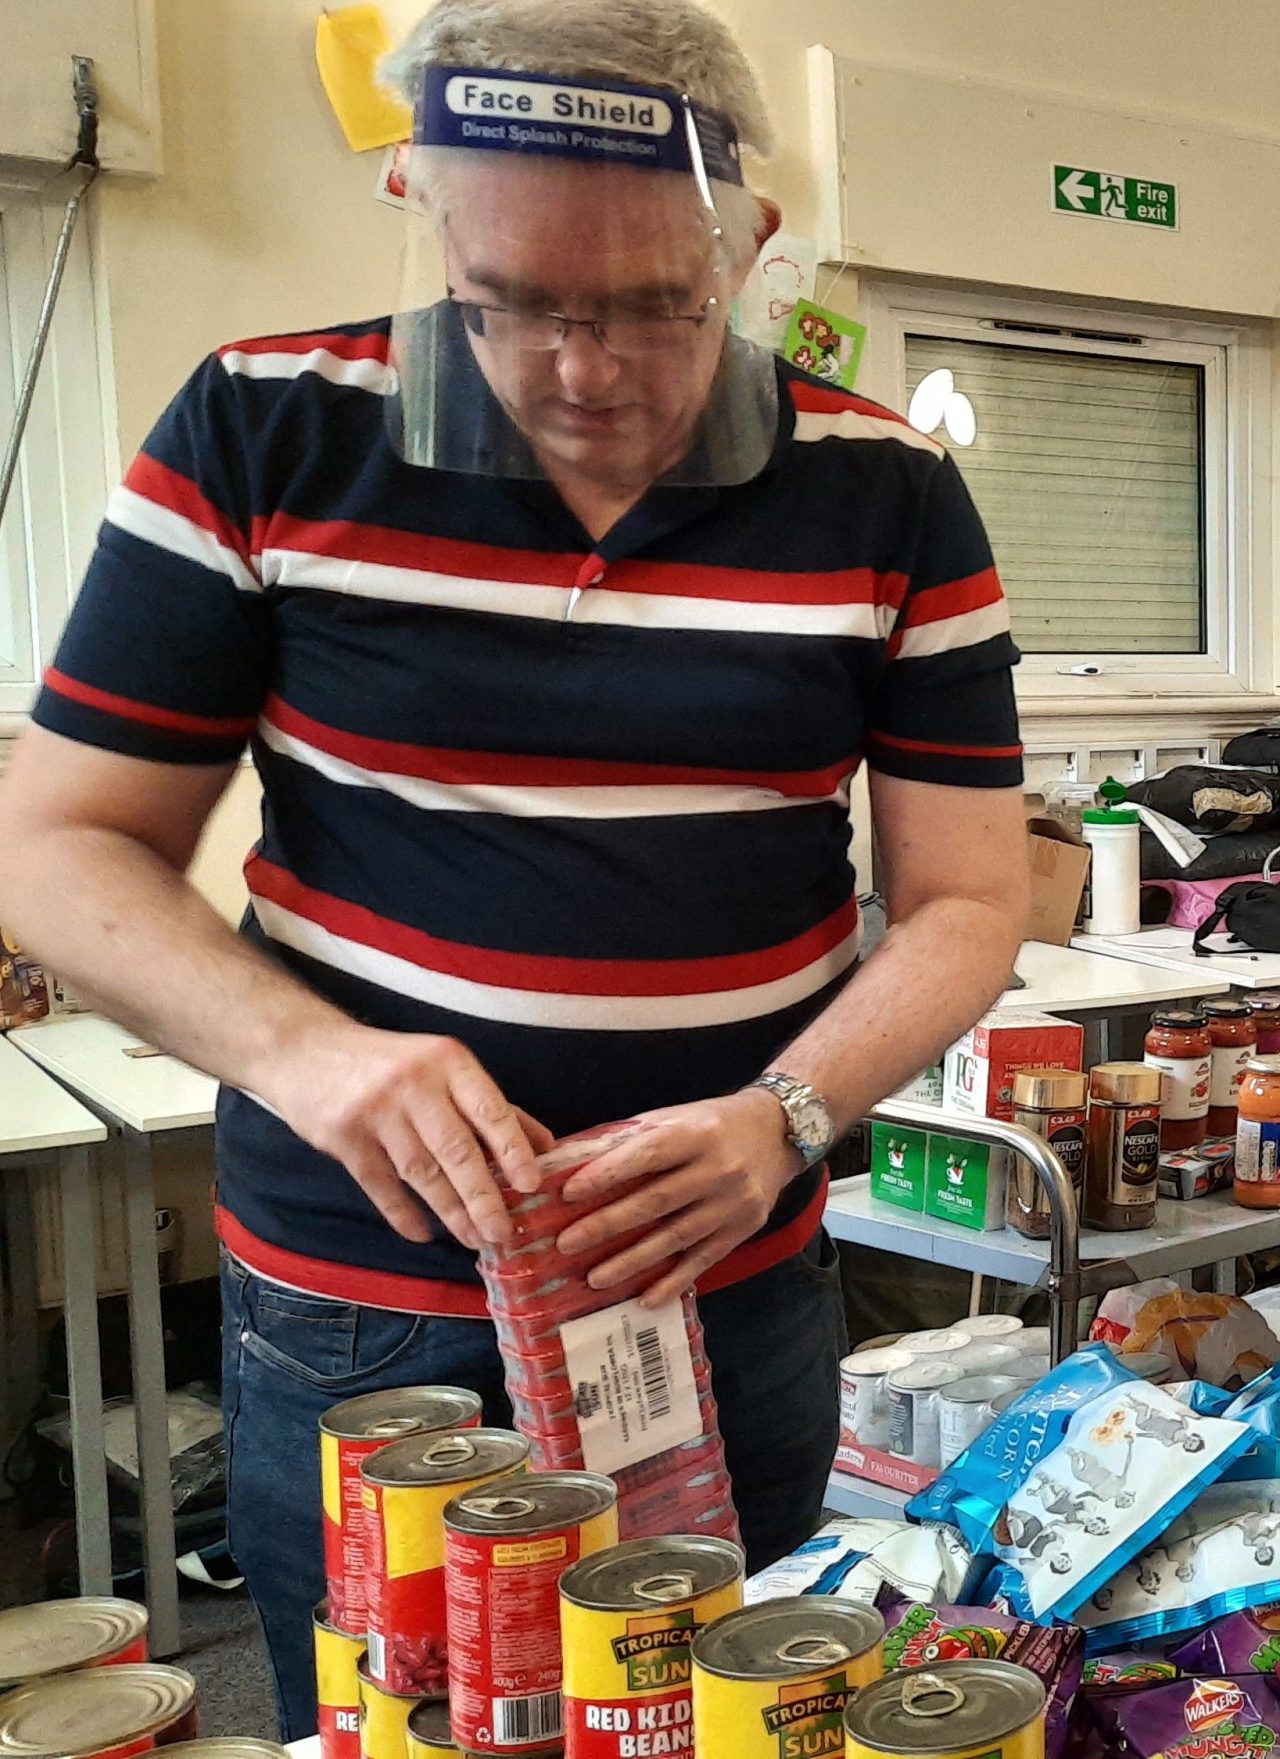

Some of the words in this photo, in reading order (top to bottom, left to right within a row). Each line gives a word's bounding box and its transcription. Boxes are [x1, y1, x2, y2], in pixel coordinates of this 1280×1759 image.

[463, 84, 533, 112] Face
[553, 92, 655, 128] Shield
[461, 121, 505, 139] Direct
[508, 124, 569, 147] Splash
[1136, 182, 1168, 203] Fire
[1137, 204, 1168, 221] exit
[1127, 1145, 1157, 1156] GOLD
[616, 1629, 693, 1656] TROPICA
[633, 1660, 690, 1687] SUN
[335, 1710, 359, 1732] RE
[585, 1704, 631, 1732] RED
[637, 1699, 692, 1731] KID
[1185, 1693, 1240, 1723] WALKERS
[785, 1725, 842, 1758] SUN
